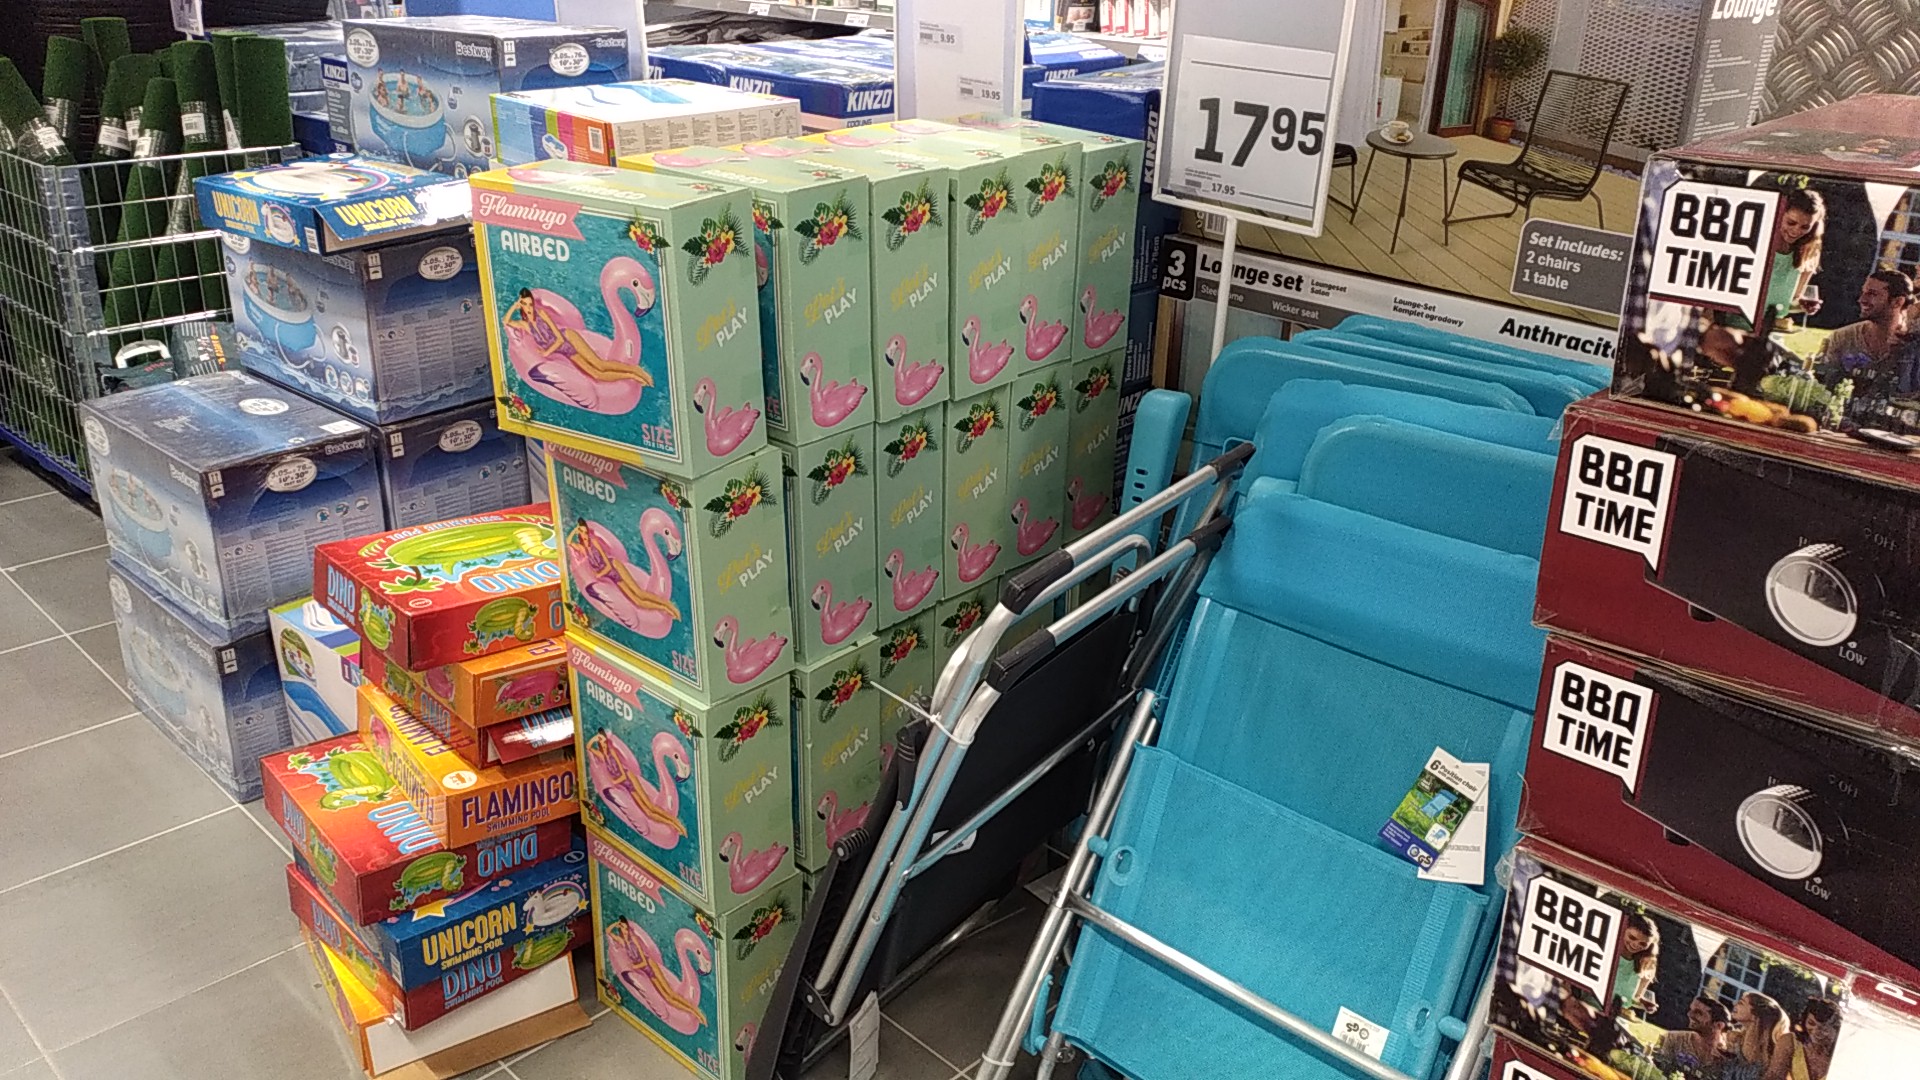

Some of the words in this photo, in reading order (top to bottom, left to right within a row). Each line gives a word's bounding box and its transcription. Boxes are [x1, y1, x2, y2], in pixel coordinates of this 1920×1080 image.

[455, 41, 493, 60] Bestway
[940, 32, 955, 44] 9.95
[729, 75, 770, 95] KINZO
[846, 89, 892, 113] KINZO
[981, 88, 1000, 101] 19.95
[1143, 110, 1159, 184] KINZO
[1211, 182, 1235, 196] 17.95
[211, 191, 261, 226] UNICORN
[334, 194, 418, 226] UNICORN
[480, 192, 567, 231] Flamingo
[1670, 193, 1765, 254] BBQ
[500, 230, 570, 262] AIRBED
[1042, 239, 1069, 271] PLAY
[1101, 232, 1127, 263] PLAY
[1526, 250, 1535, 264] 2
[1537, 254, 1581, 273] chairs
[1529, 232, 1552, 246] Set
[1554, 236, 1624, 261] includes:
[984, 256, 1011, 290] PLAY
[1167, 249, 1187, 276] 3
[1200, 254, 1269, 286] Longe
[1272, 273, 1305, 292] set
[908, 272, 938, 308] PLAY
[1162, 276, 1189, 292] pcs
[1200, 284, 1220, 296] Stee
[1310, 279, 1347, 293] Loungeset
[1310, 286, 1330, 297] Salon
[1522, 269, 1531, 281] 1
[1533, 270, 1569, 290] table
[823, 288, 857, 324] PLAY
[1272, 300, 1299, 314] Wicker
[1301, 306, 1319, 319] seat
[1393, 296, 1436, 312] Lounge-Set
[1393, 305, 1425, 320] Komplet
[1425, 311, 1465, 328] ogrodowy
[716, 307, 747, 347] PLAY
[766, 397, 779, 414] ZE
[324, 439, 366, 456] Bestway
[641, 423, 673, 446] SIZE
[1086, 425, 1111, 454] PLAY
[1033, 445, 1060, 475] PLAY
[1578, 444, 1663, 508] BBQ
[563, 466, 616, 503] AIRBED
[972, 467, 999, 499] PLAY
[906, 489, 934, 524] PLAY
[386, 528, 421, 542] POOL
[833, 517, 864, 552] PLAY
[468, 561, 560, 594] DINO
[738, 549, 774, 587] PLAY
[328, 564, 356, 613] DINO
[572, 647, 632, 693] Flamingo
[671, 650, 695, 677] SIZE
[1838, 646, 1867, 667] LOW
[586, 680, 633, 721] AIRBED
[1561, 670, 1641, 736] BBQ
[840, 727, 869, 764] PLAY
[744, 766, 778, 804] PLAY
[1430, 760, 1441, 771] 6
[1440, 764, 1463, 784] Position
[1461, 779, 1478, 793] chair
[462, 771, 576, 828] FLAMINGO
[367, 800, 440, 854] DINO
[486, 815, 529, 833] SWIMMING
[531, 807, 550, 819] POOL
[477, 832, 538, 877] DINO
[593, 839, 654, 889] Flamingo
[1418, 854, 1432, 866] GS
[608, 870, 656, 914] AIRBED
[1804, 882, 1832, 901] LOW
[422, 902, 517, 966] UNICORN
[1534, 884, 1612, 953] BBQ
[441, 947, 483, 970] SWIMMING
[484, 937, 504, 952] POOL
[442, 952, 502, 1000] DINO
[444, 984, 484, 1009] SWIMMING
[485, 975, 504, 990] POOL
[759, 962, 785, 994] PLA
[697, 1048, 719, 1074] SIZE
